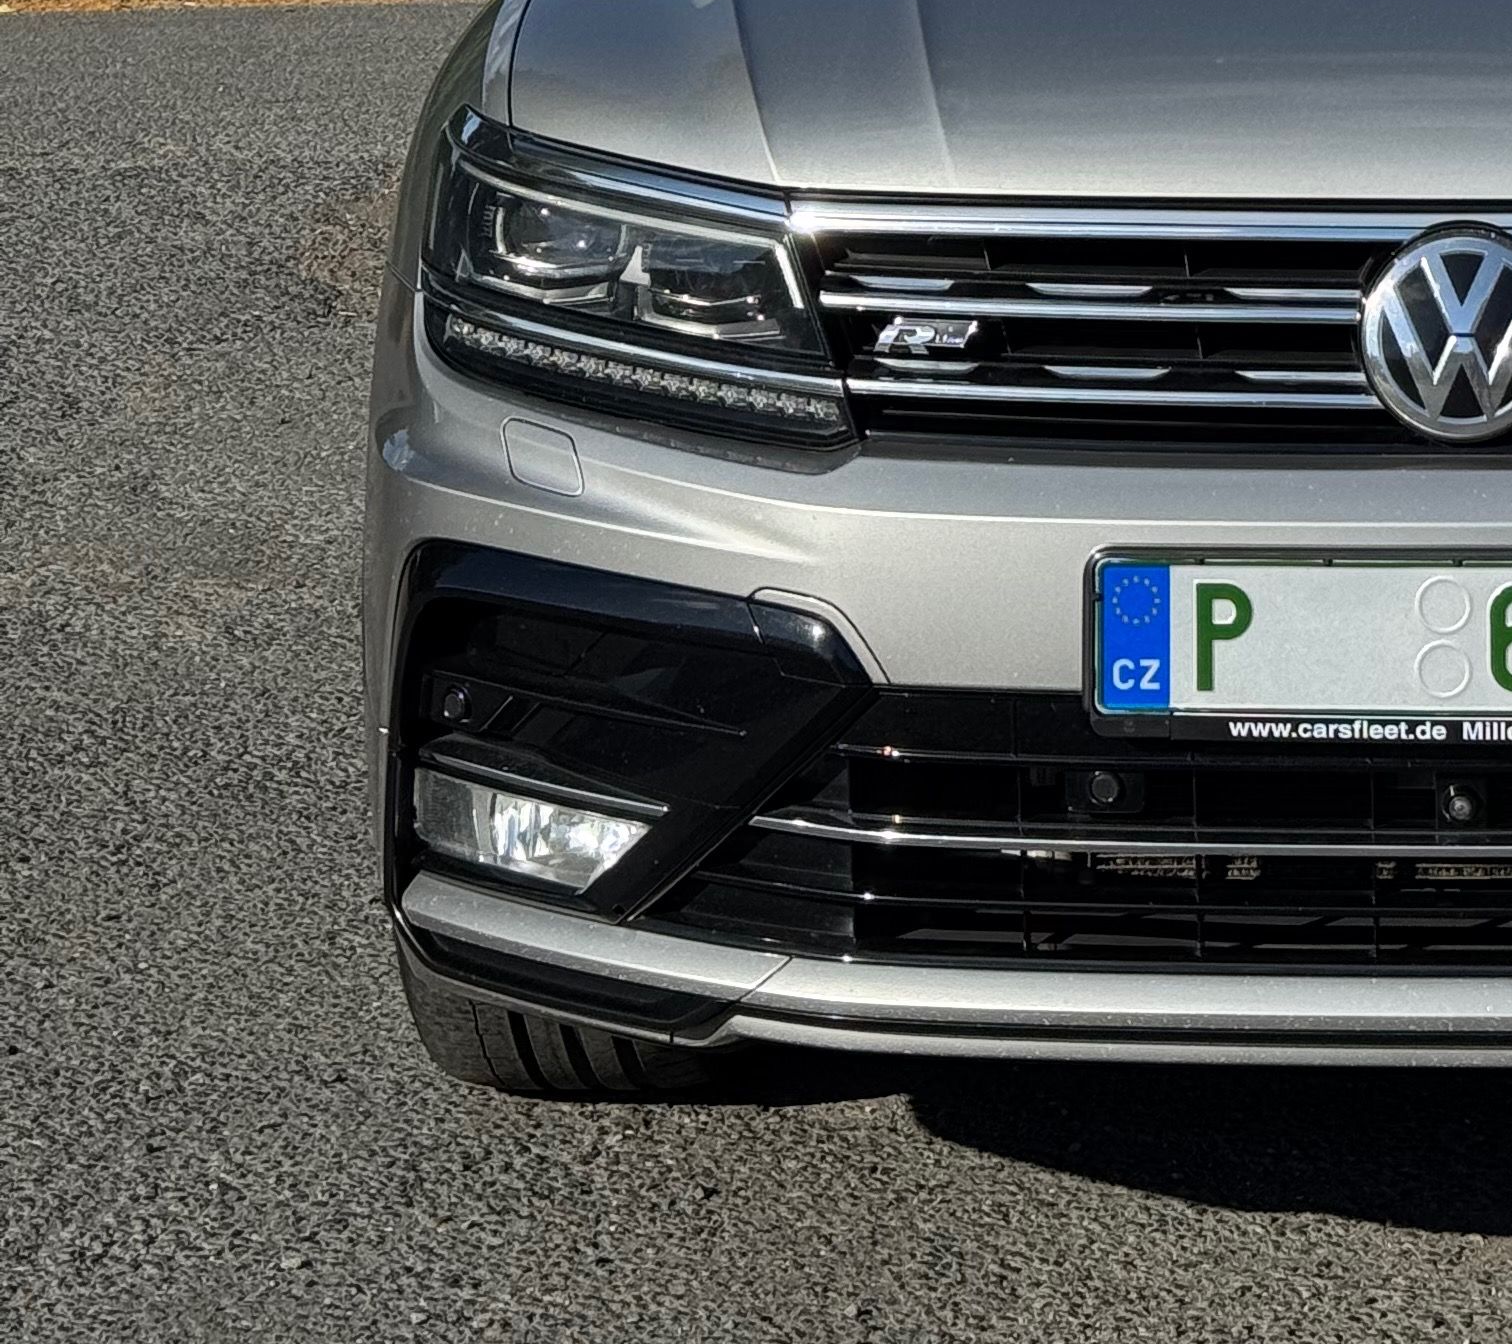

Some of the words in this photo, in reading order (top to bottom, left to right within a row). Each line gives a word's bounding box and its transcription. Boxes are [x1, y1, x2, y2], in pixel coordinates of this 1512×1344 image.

[872, 323, 936, 356] R
[1111, 658, 1161, 690] CZ
[1196, 582, 1253, 692] P
[1228, 720, 1448, 740] www.carsfleet.de
